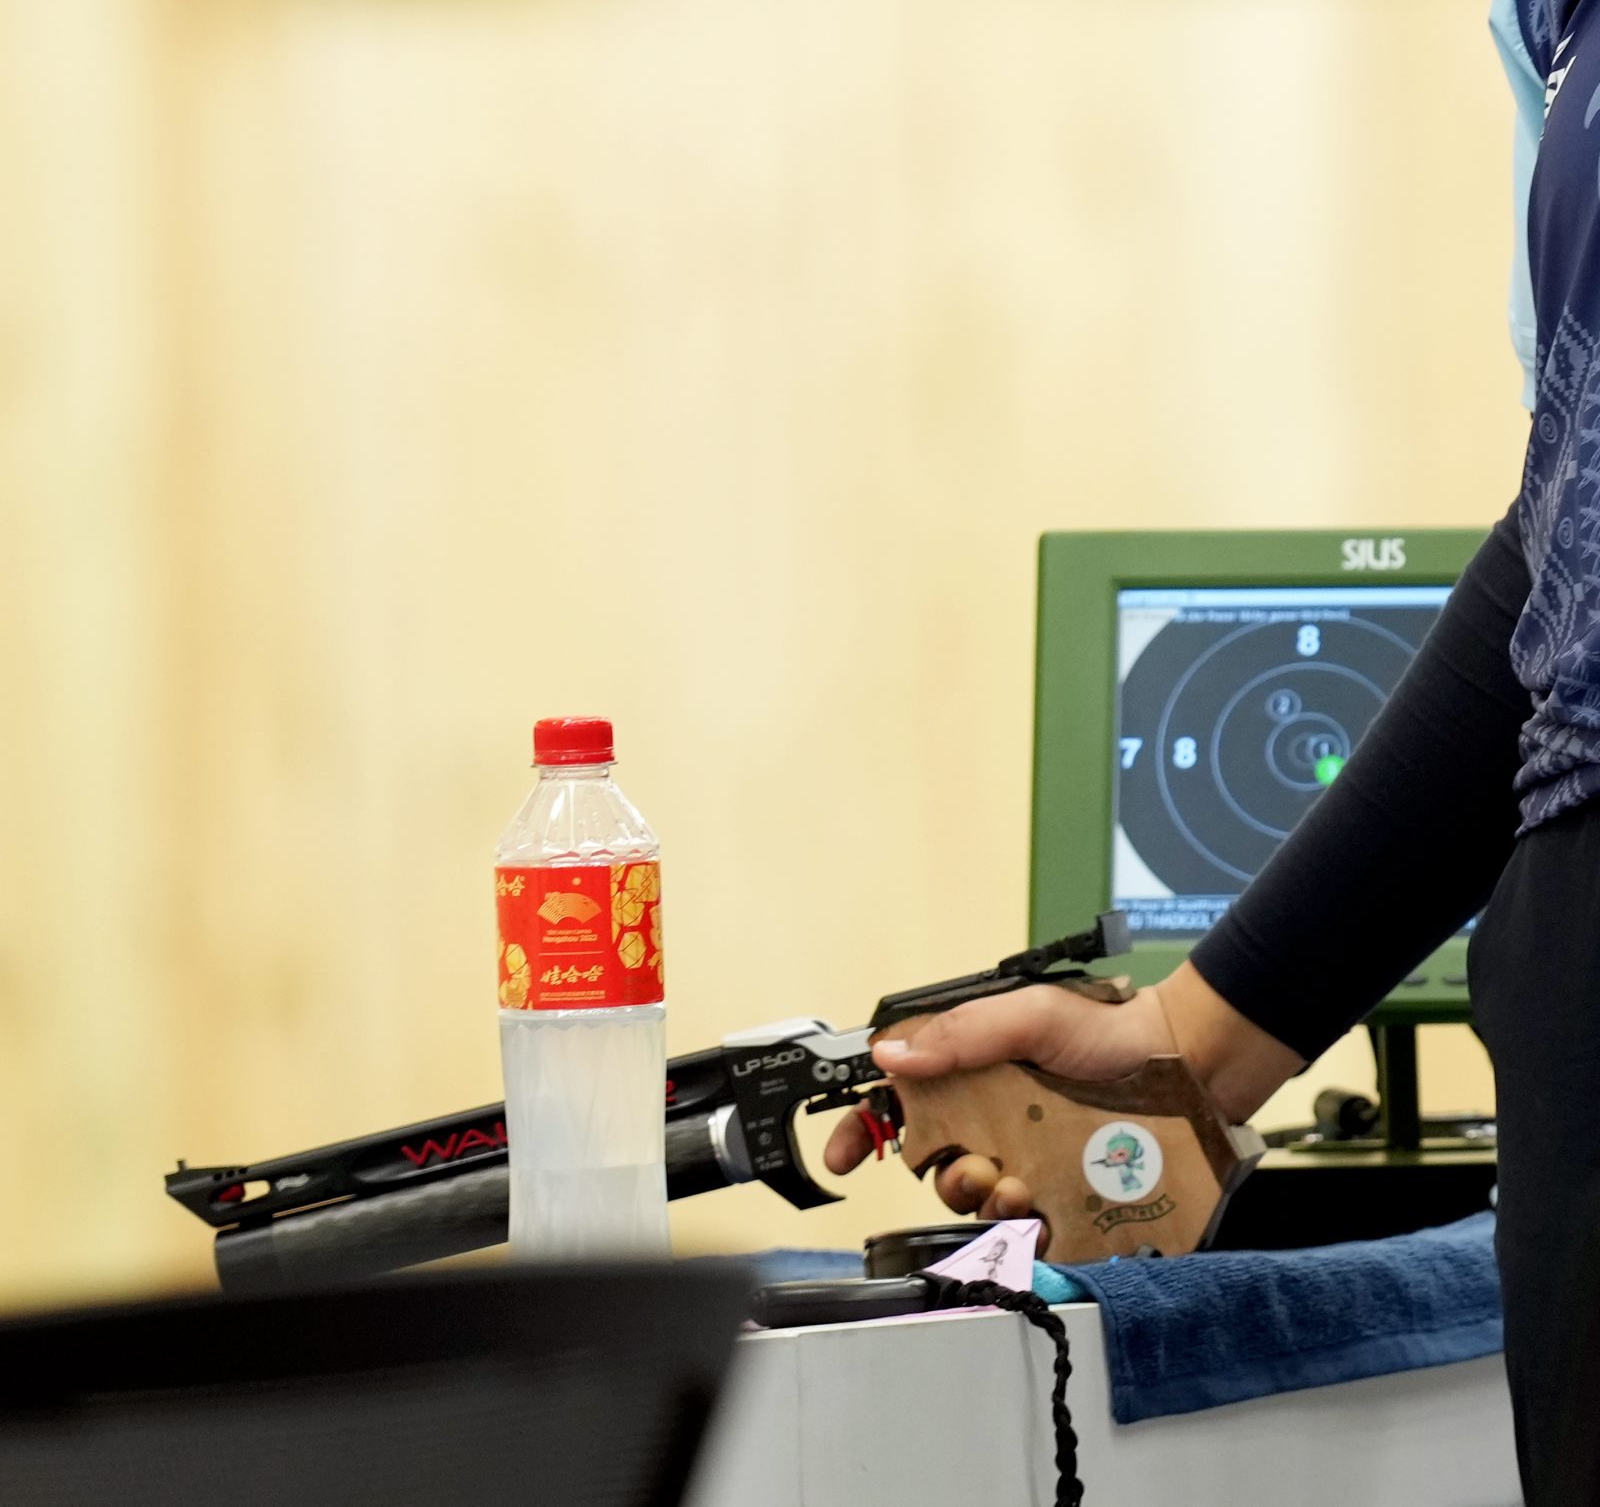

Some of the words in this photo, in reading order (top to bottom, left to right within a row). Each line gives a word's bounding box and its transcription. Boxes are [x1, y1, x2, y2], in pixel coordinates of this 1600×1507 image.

[1341, 538, 1406, 572] SIUS
[1297, 624, 1320, 656] 8
[1119, 737, 1143, 769] 7
[1173, 736, 1197, 769] 8
